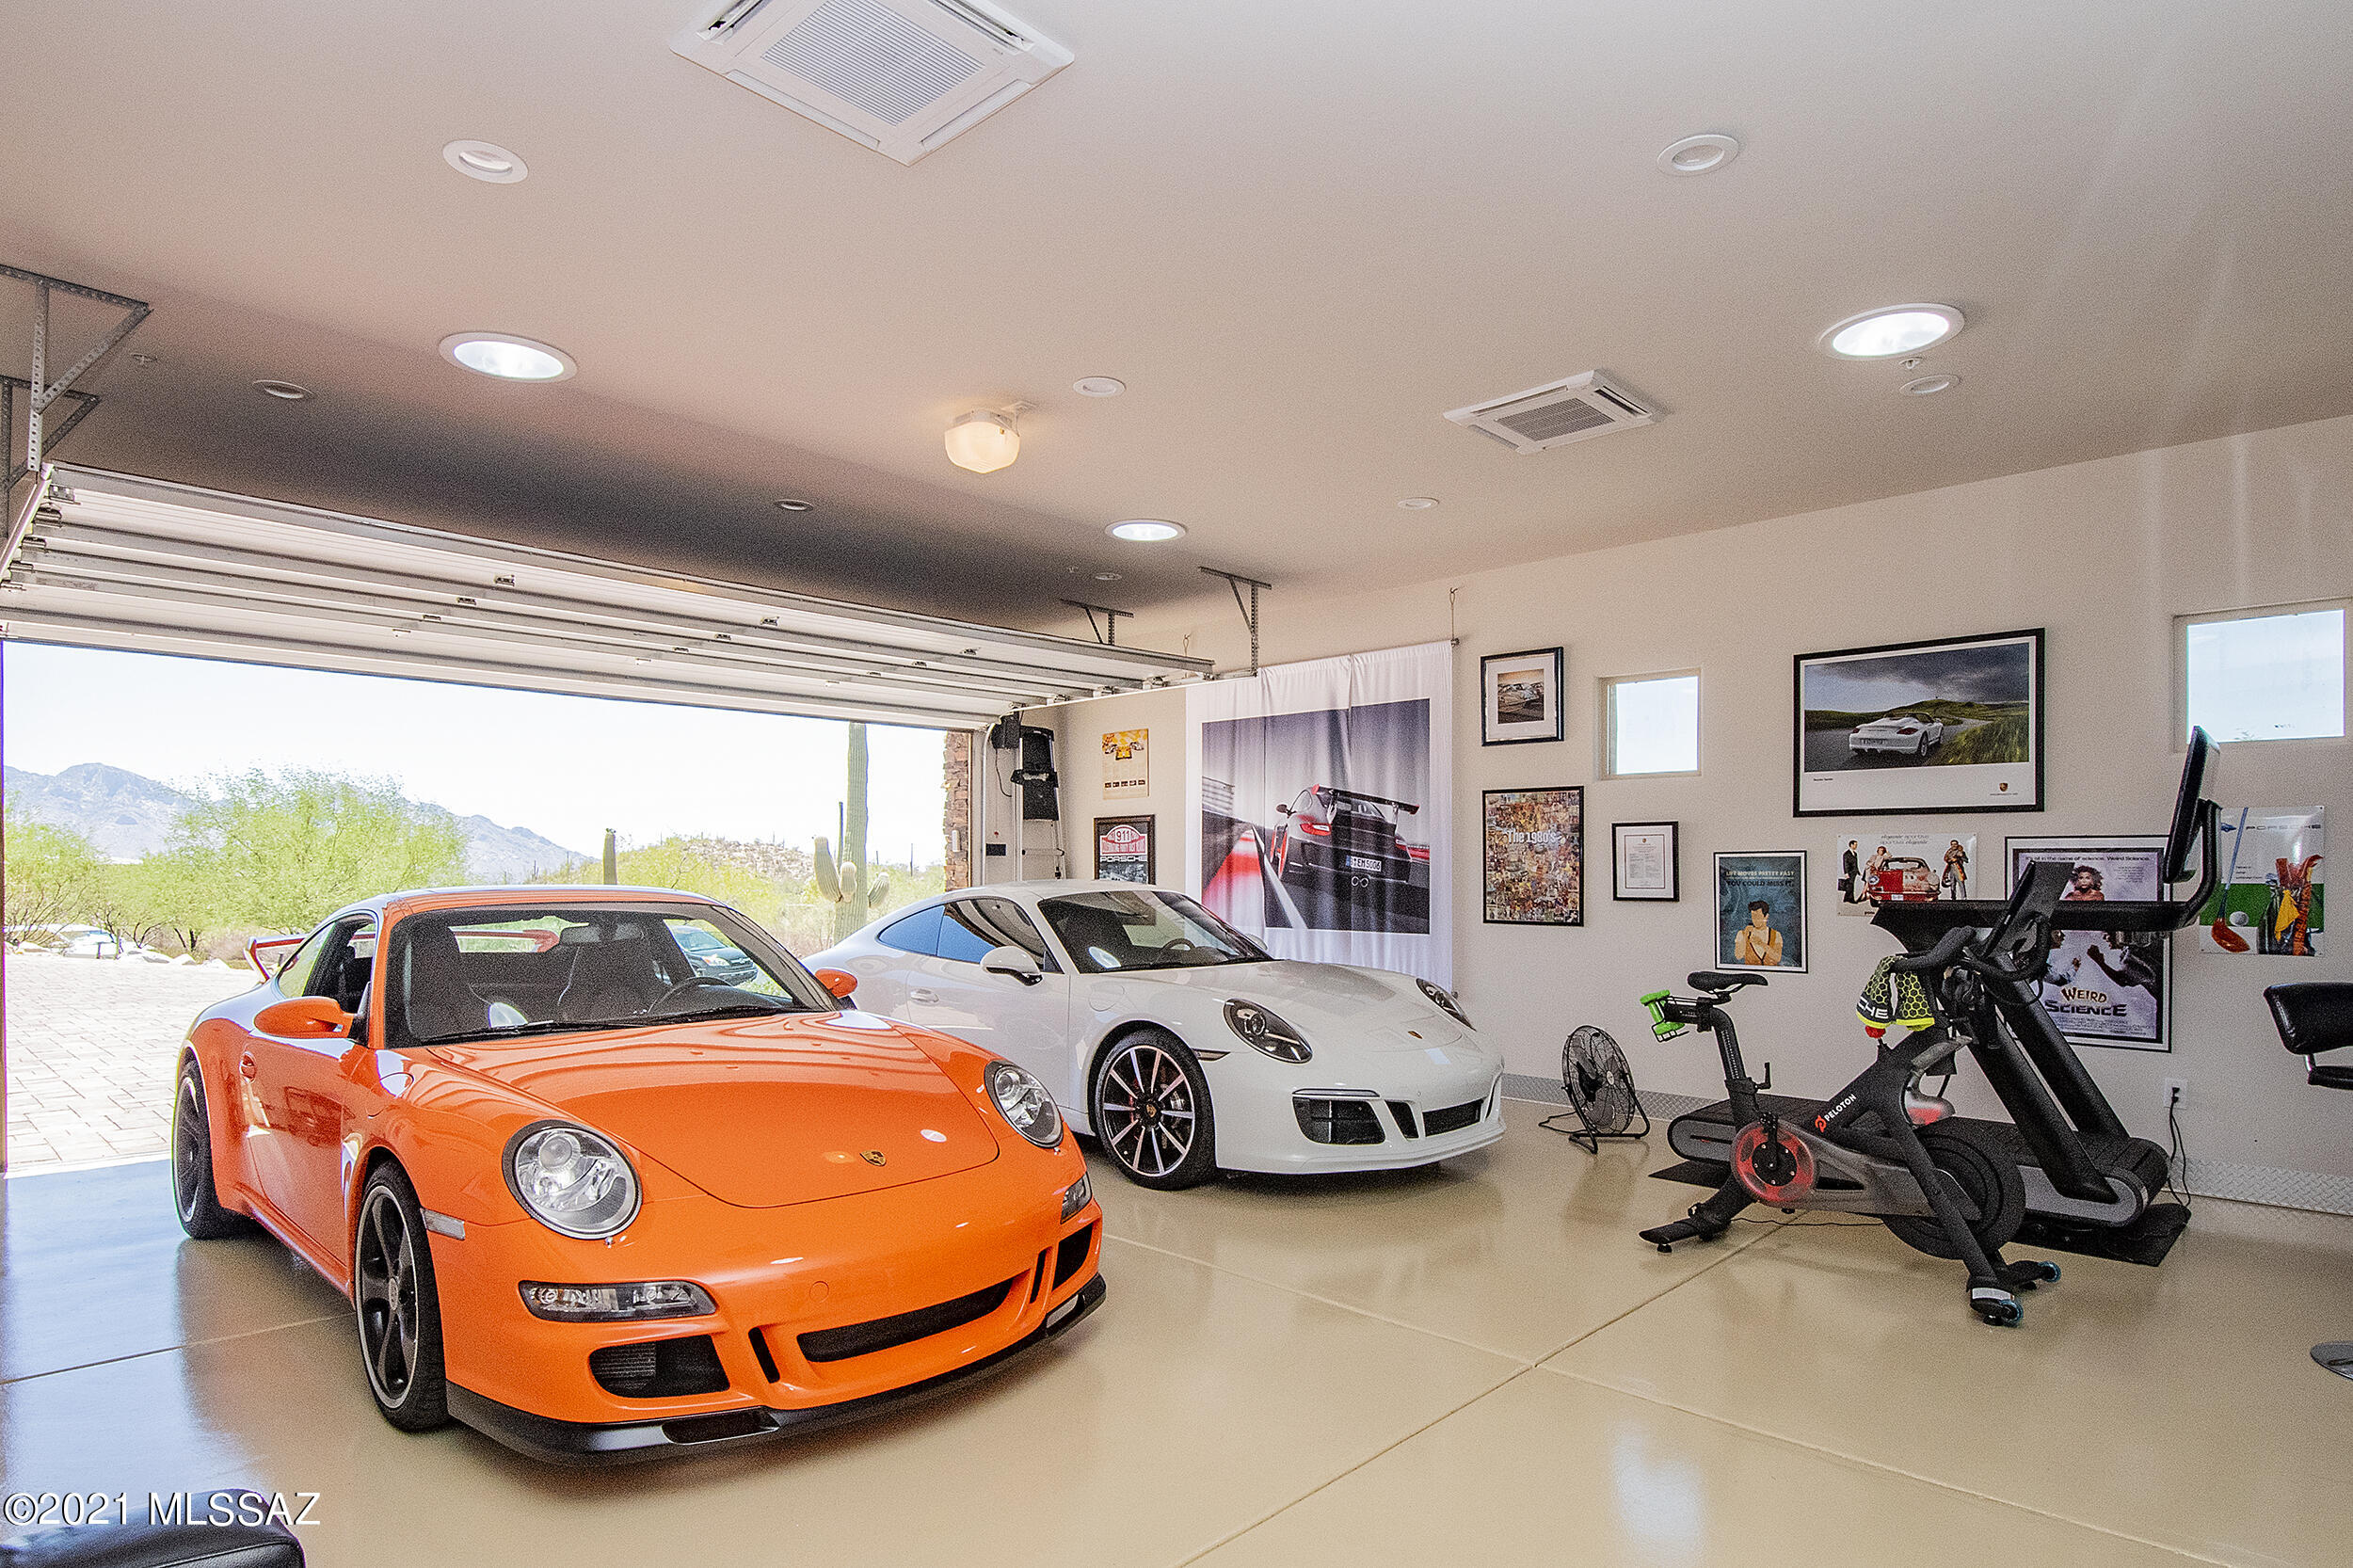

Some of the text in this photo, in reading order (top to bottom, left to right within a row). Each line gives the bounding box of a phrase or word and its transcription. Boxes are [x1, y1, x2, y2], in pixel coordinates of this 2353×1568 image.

[1116, 830, 1129, 841] 911
[1507, 828, 1557, 844] The 1980's
[2061, 987, 2107, 1003] WEIRD
[2044, 1000, 2127, 1016] SCIENCE
[1824, 1094, 1857, 1121] PELOTON
